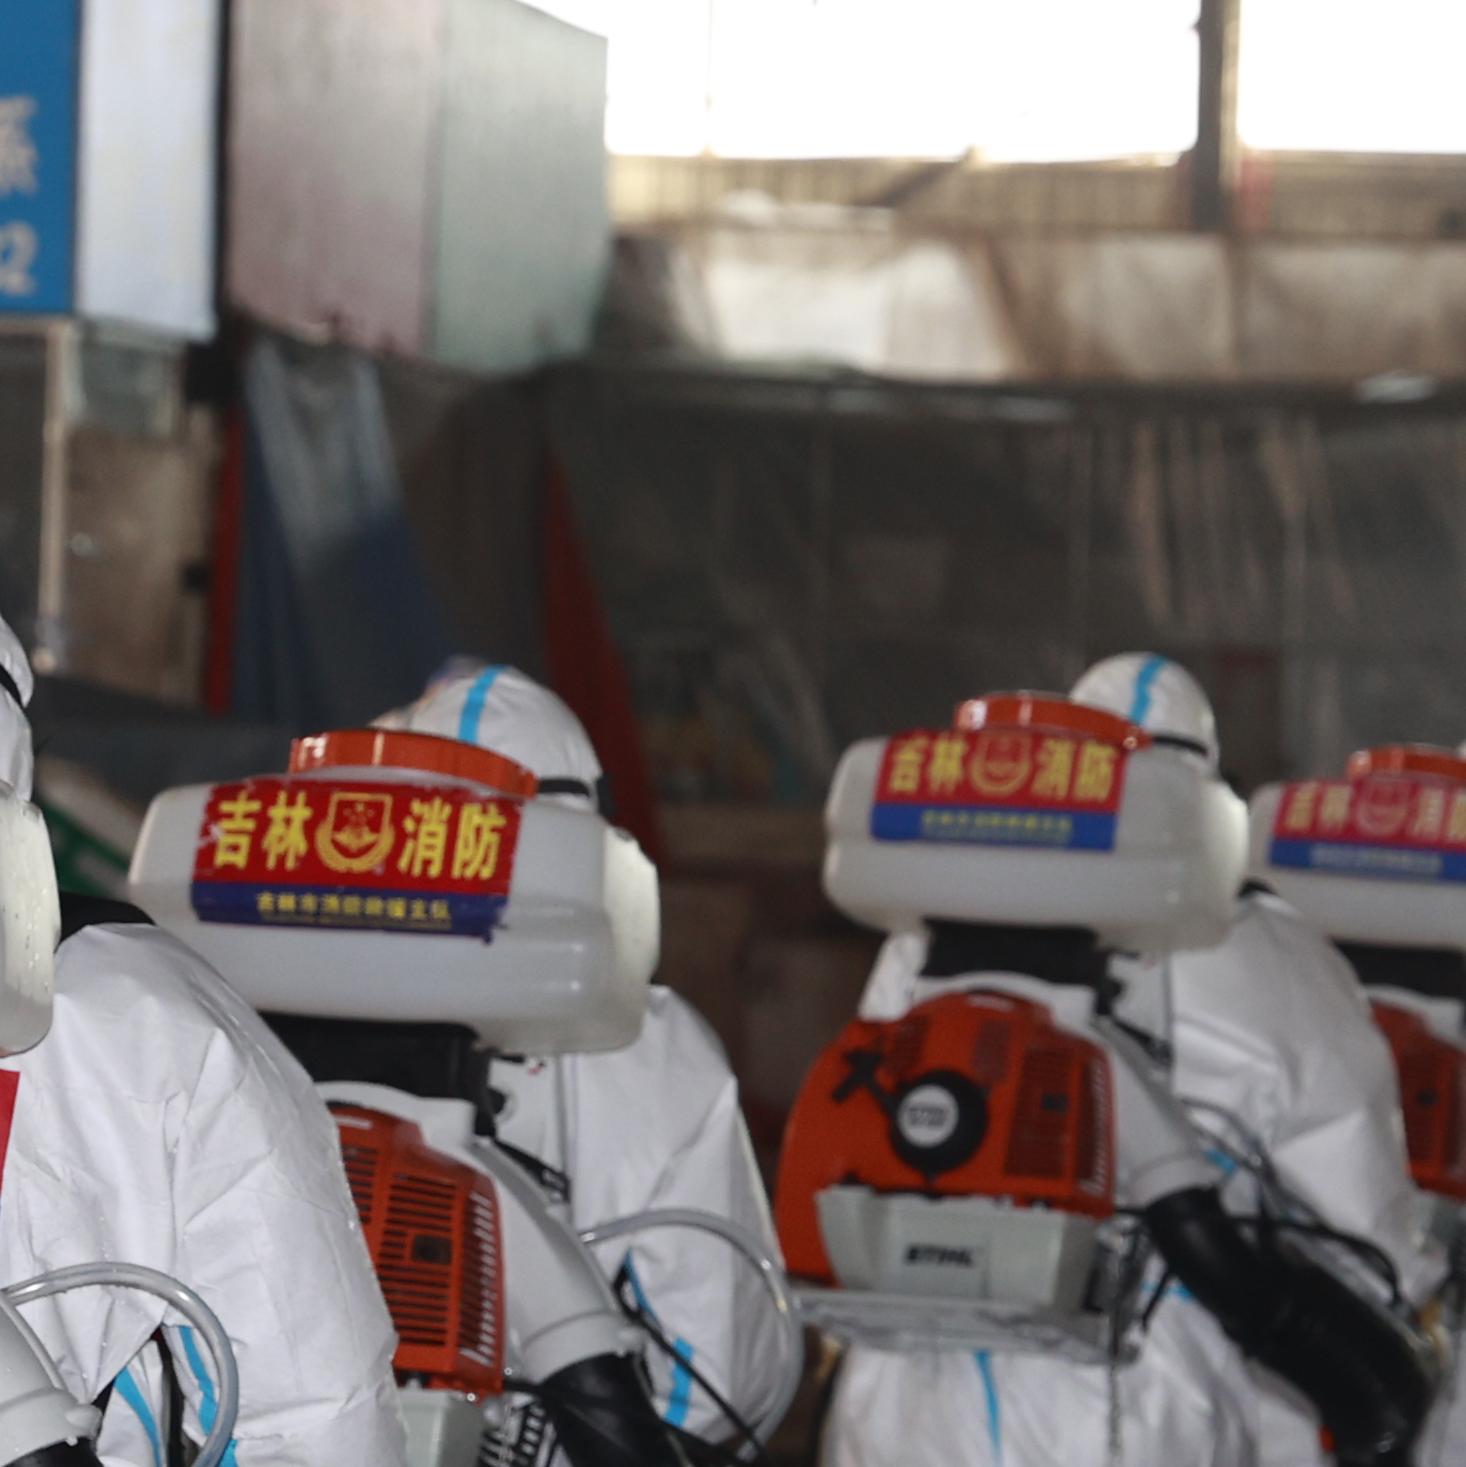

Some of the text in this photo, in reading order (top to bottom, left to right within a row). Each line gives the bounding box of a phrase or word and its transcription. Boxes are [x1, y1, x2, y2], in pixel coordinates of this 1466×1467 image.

[887, 732, 1117, 803] 吉林 消防
[214, 790, 507, 879] 吉林 消防
